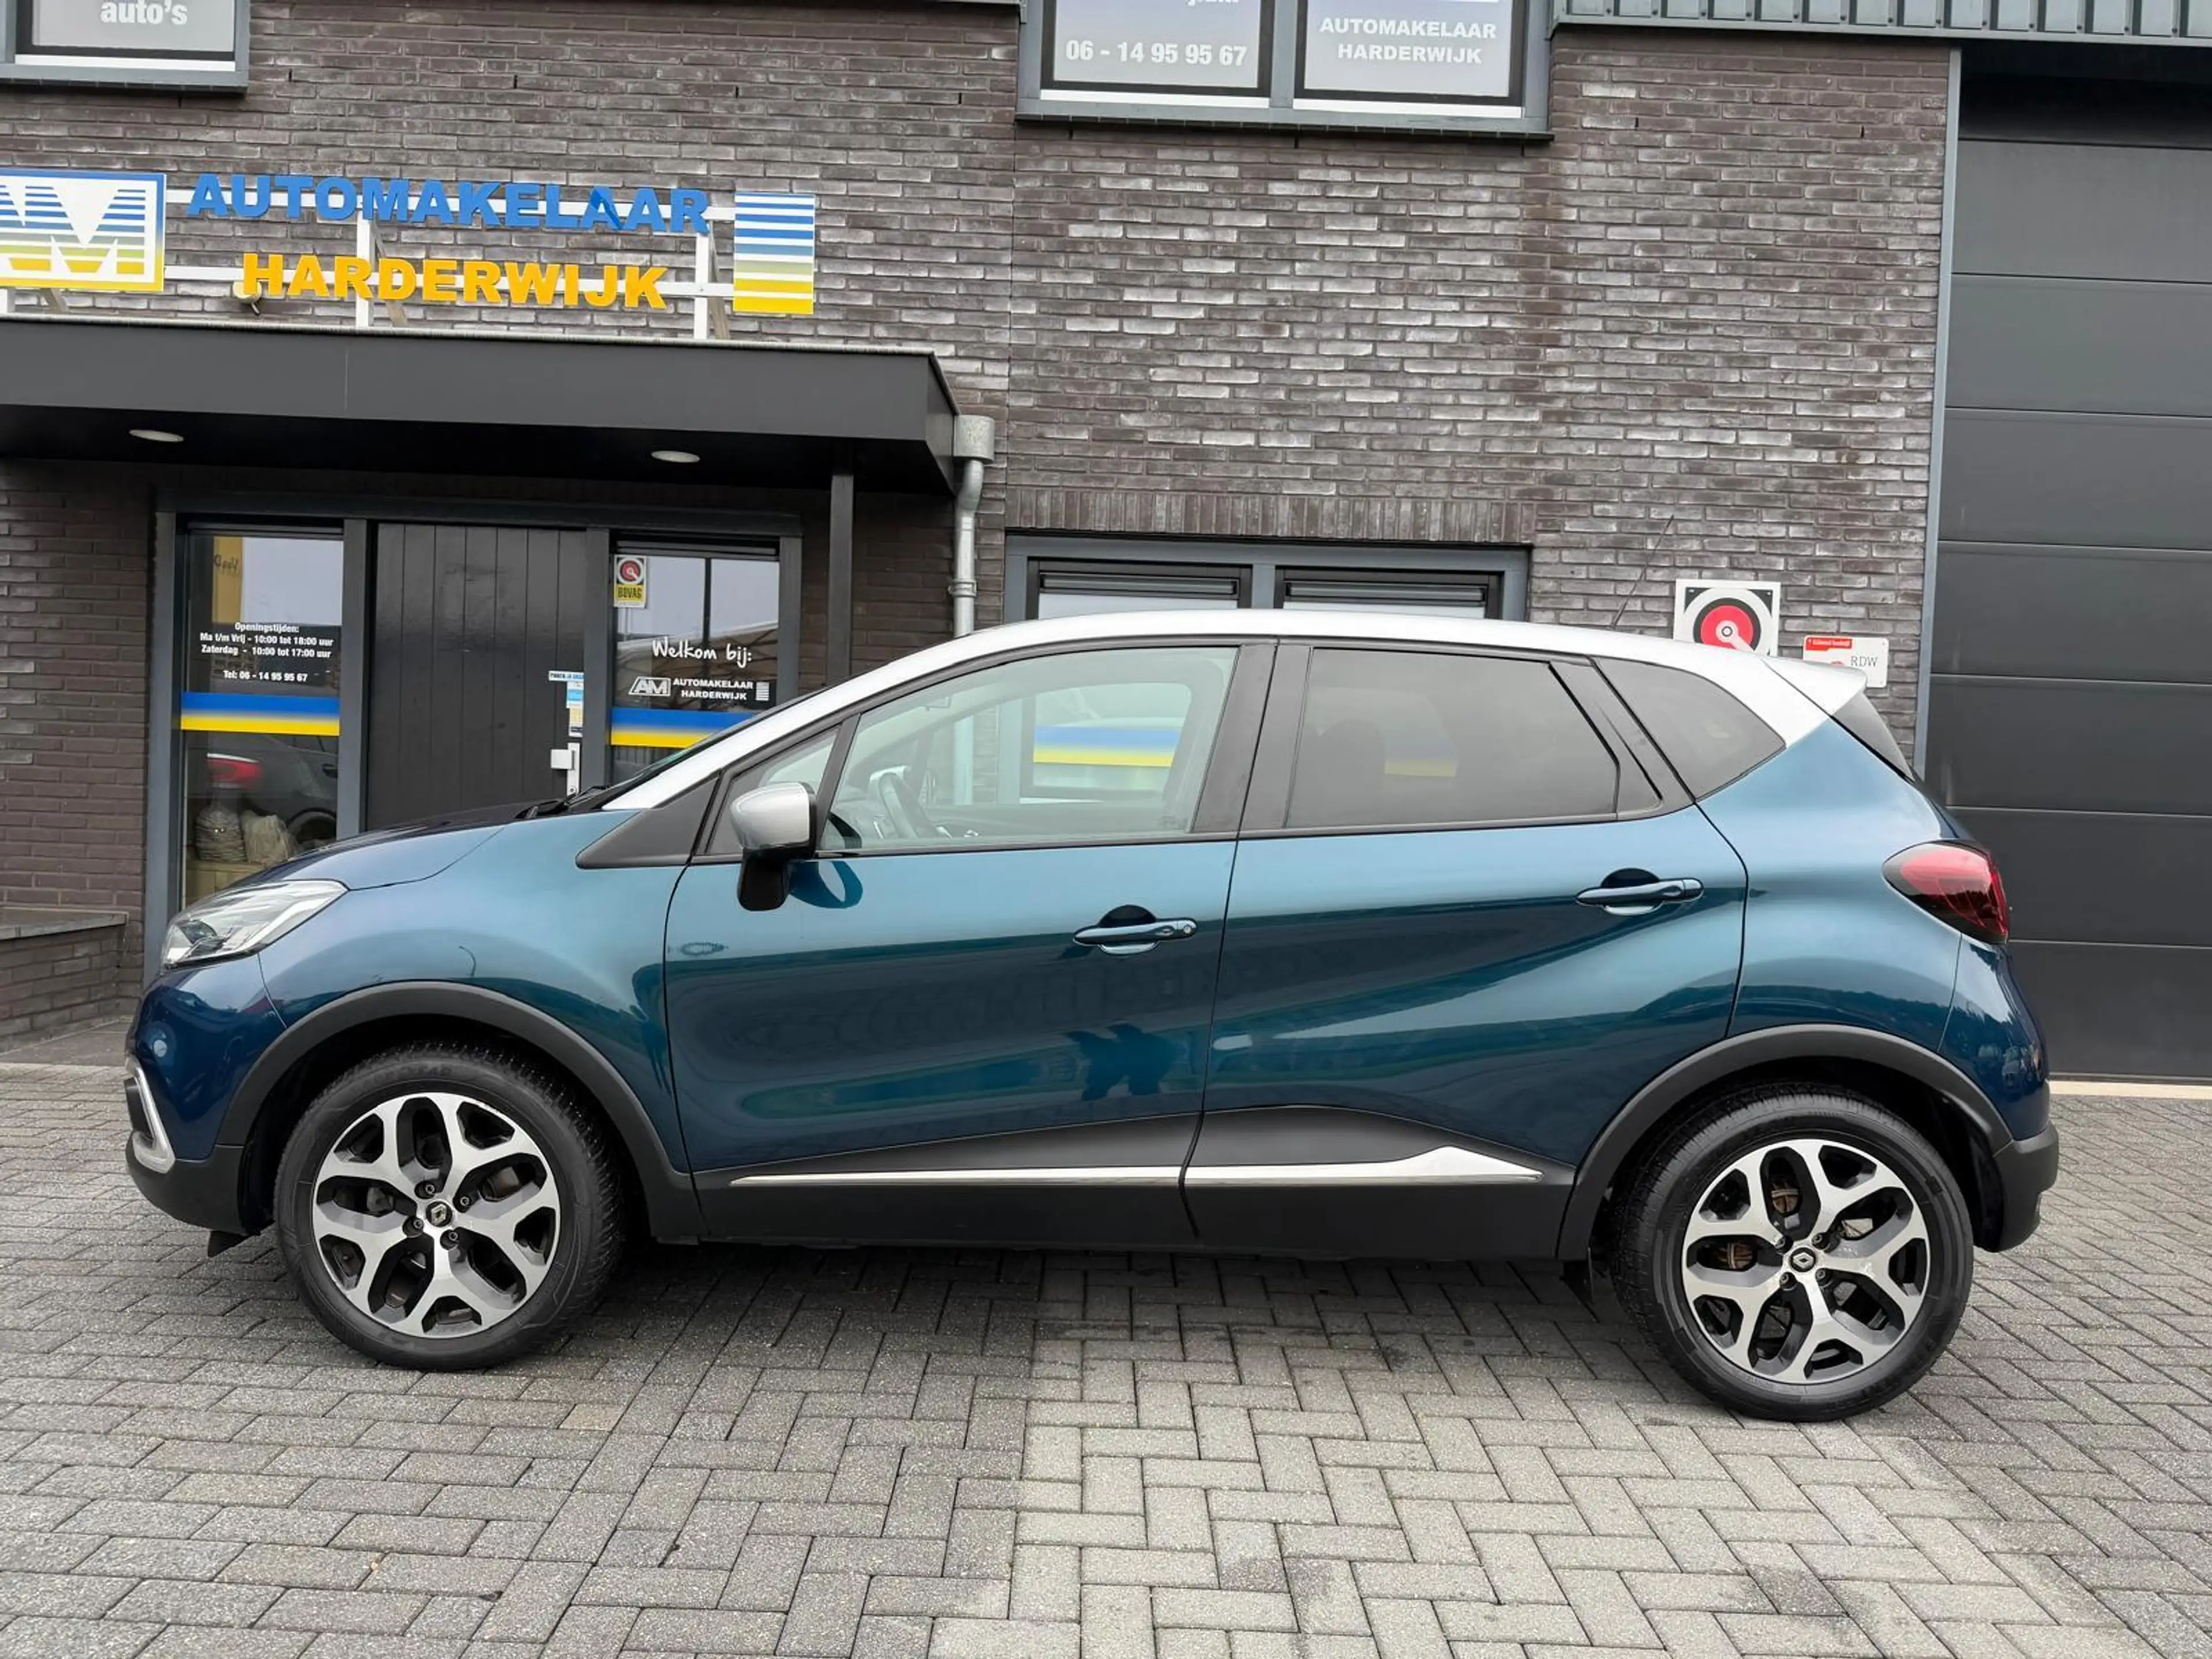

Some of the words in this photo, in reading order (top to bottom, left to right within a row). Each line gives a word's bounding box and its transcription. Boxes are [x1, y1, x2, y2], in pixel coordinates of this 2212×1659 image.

[100, 0, 188, 25] auto's
[1319, 17, 1497, 39] AUTOMAKELAAR
[1066, 40, 1094, 61] 06
[1118, 41, 1145, 63] 14
[1151, 43, 1179, 64] 95
[1185, 44, 1213, 65] 95
[1219, 46, 1247, 66] 67
[1338, 43, 1482, 65] HARDERWIJK
[186, 173, 710, 234] AUTOMAKELAAR
[242, 252, 667, 310] HARDERWIJK
[618, 586, 642, 599] BOVAG
[234, 622, 300, 633] Openingstijden:
[200, 632, 213, 641] Ma
[231, 634, 245, 643] Vrij
[254, 635, 277, 644] 10:00
[279, 637, 291, 645] tot
[293, 637, 317, 645] 18:00
[319, 638, 334, 646] uur
[201, 644, 238, 656] Zaterdag
[252, 647, 275, 656] 10:00
[277, 648, 289, 657] tot
[291, 648, 315, 657] 17:00
[316, 650, 332, 658] uur
[652, 637, 717, 661] Welkom
[725, 643, 752, 669] bij:
[1850, 654, 1878, 668] RDW
[224, 670, 237, 679] Tel:
[238, 671, 250, 679] 06
[259, 672, 269, 680] 14
[271, 672, 282, 680] 95
[284, 673, 295, 681] 95
[297, 673, 308, 681] 67
[632, 679, 669, 695] AM
[672, 677, 753, 690] AUTOMAKELAAR
[680, 690, 747, 700] HARDERWIJK
